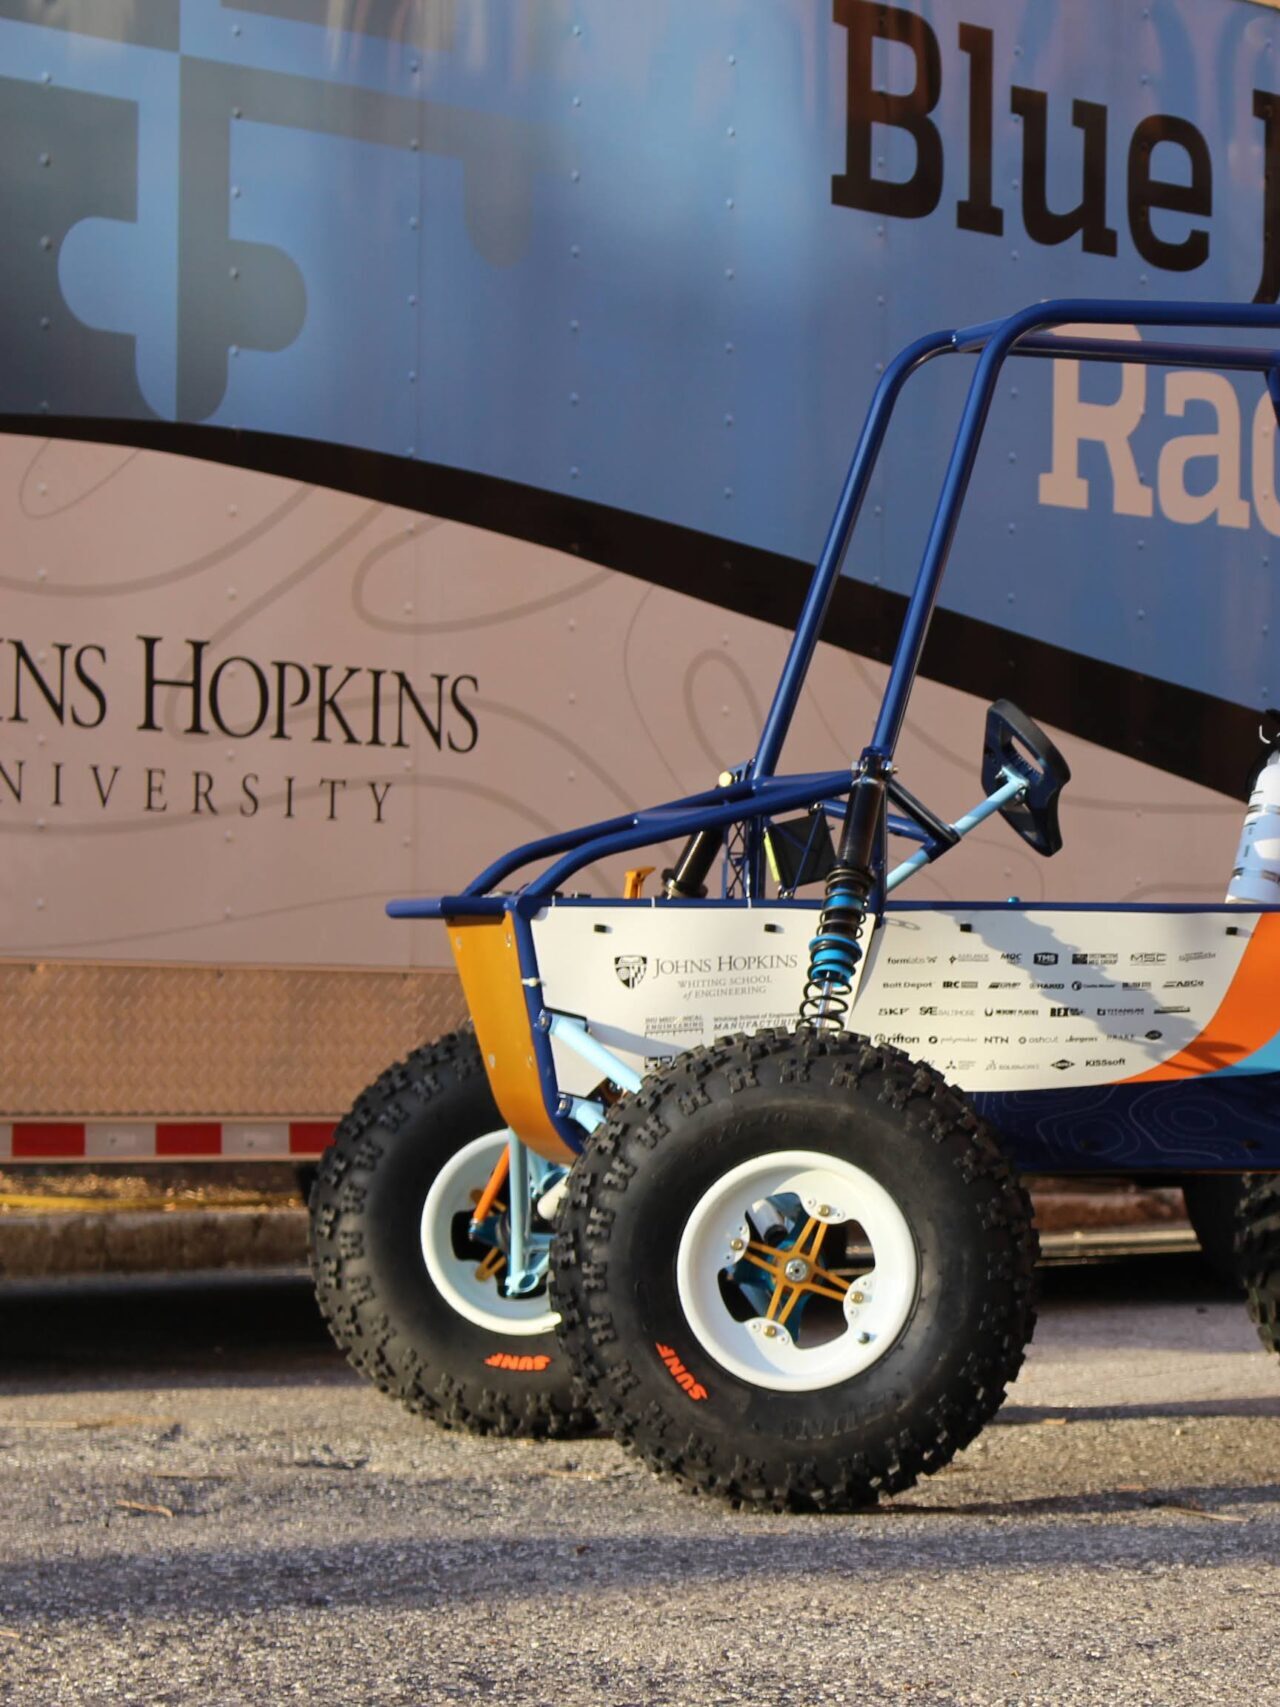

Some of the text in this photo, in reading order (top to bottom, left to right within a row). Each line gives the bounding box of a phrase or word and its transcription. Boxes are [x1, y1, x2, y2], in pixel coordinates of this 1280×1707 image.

[831, 0, 1212, 272] Blue
[0, 634, 480, 754] NS HOPKINS
[1130, 953, 1167, 962] MSC
[653, 954, 798, 980] JOHNS HOPKINS
[678, 974, 773, 989] WHITING SCHOOL
[694, 985, 767, 999] ENGINEERING
[878, 1007, 910, 1016] SKF
[714, 1018, 798, 1031] MANUFACTURIN
[984, 1035, 1010, 1044] NTN
